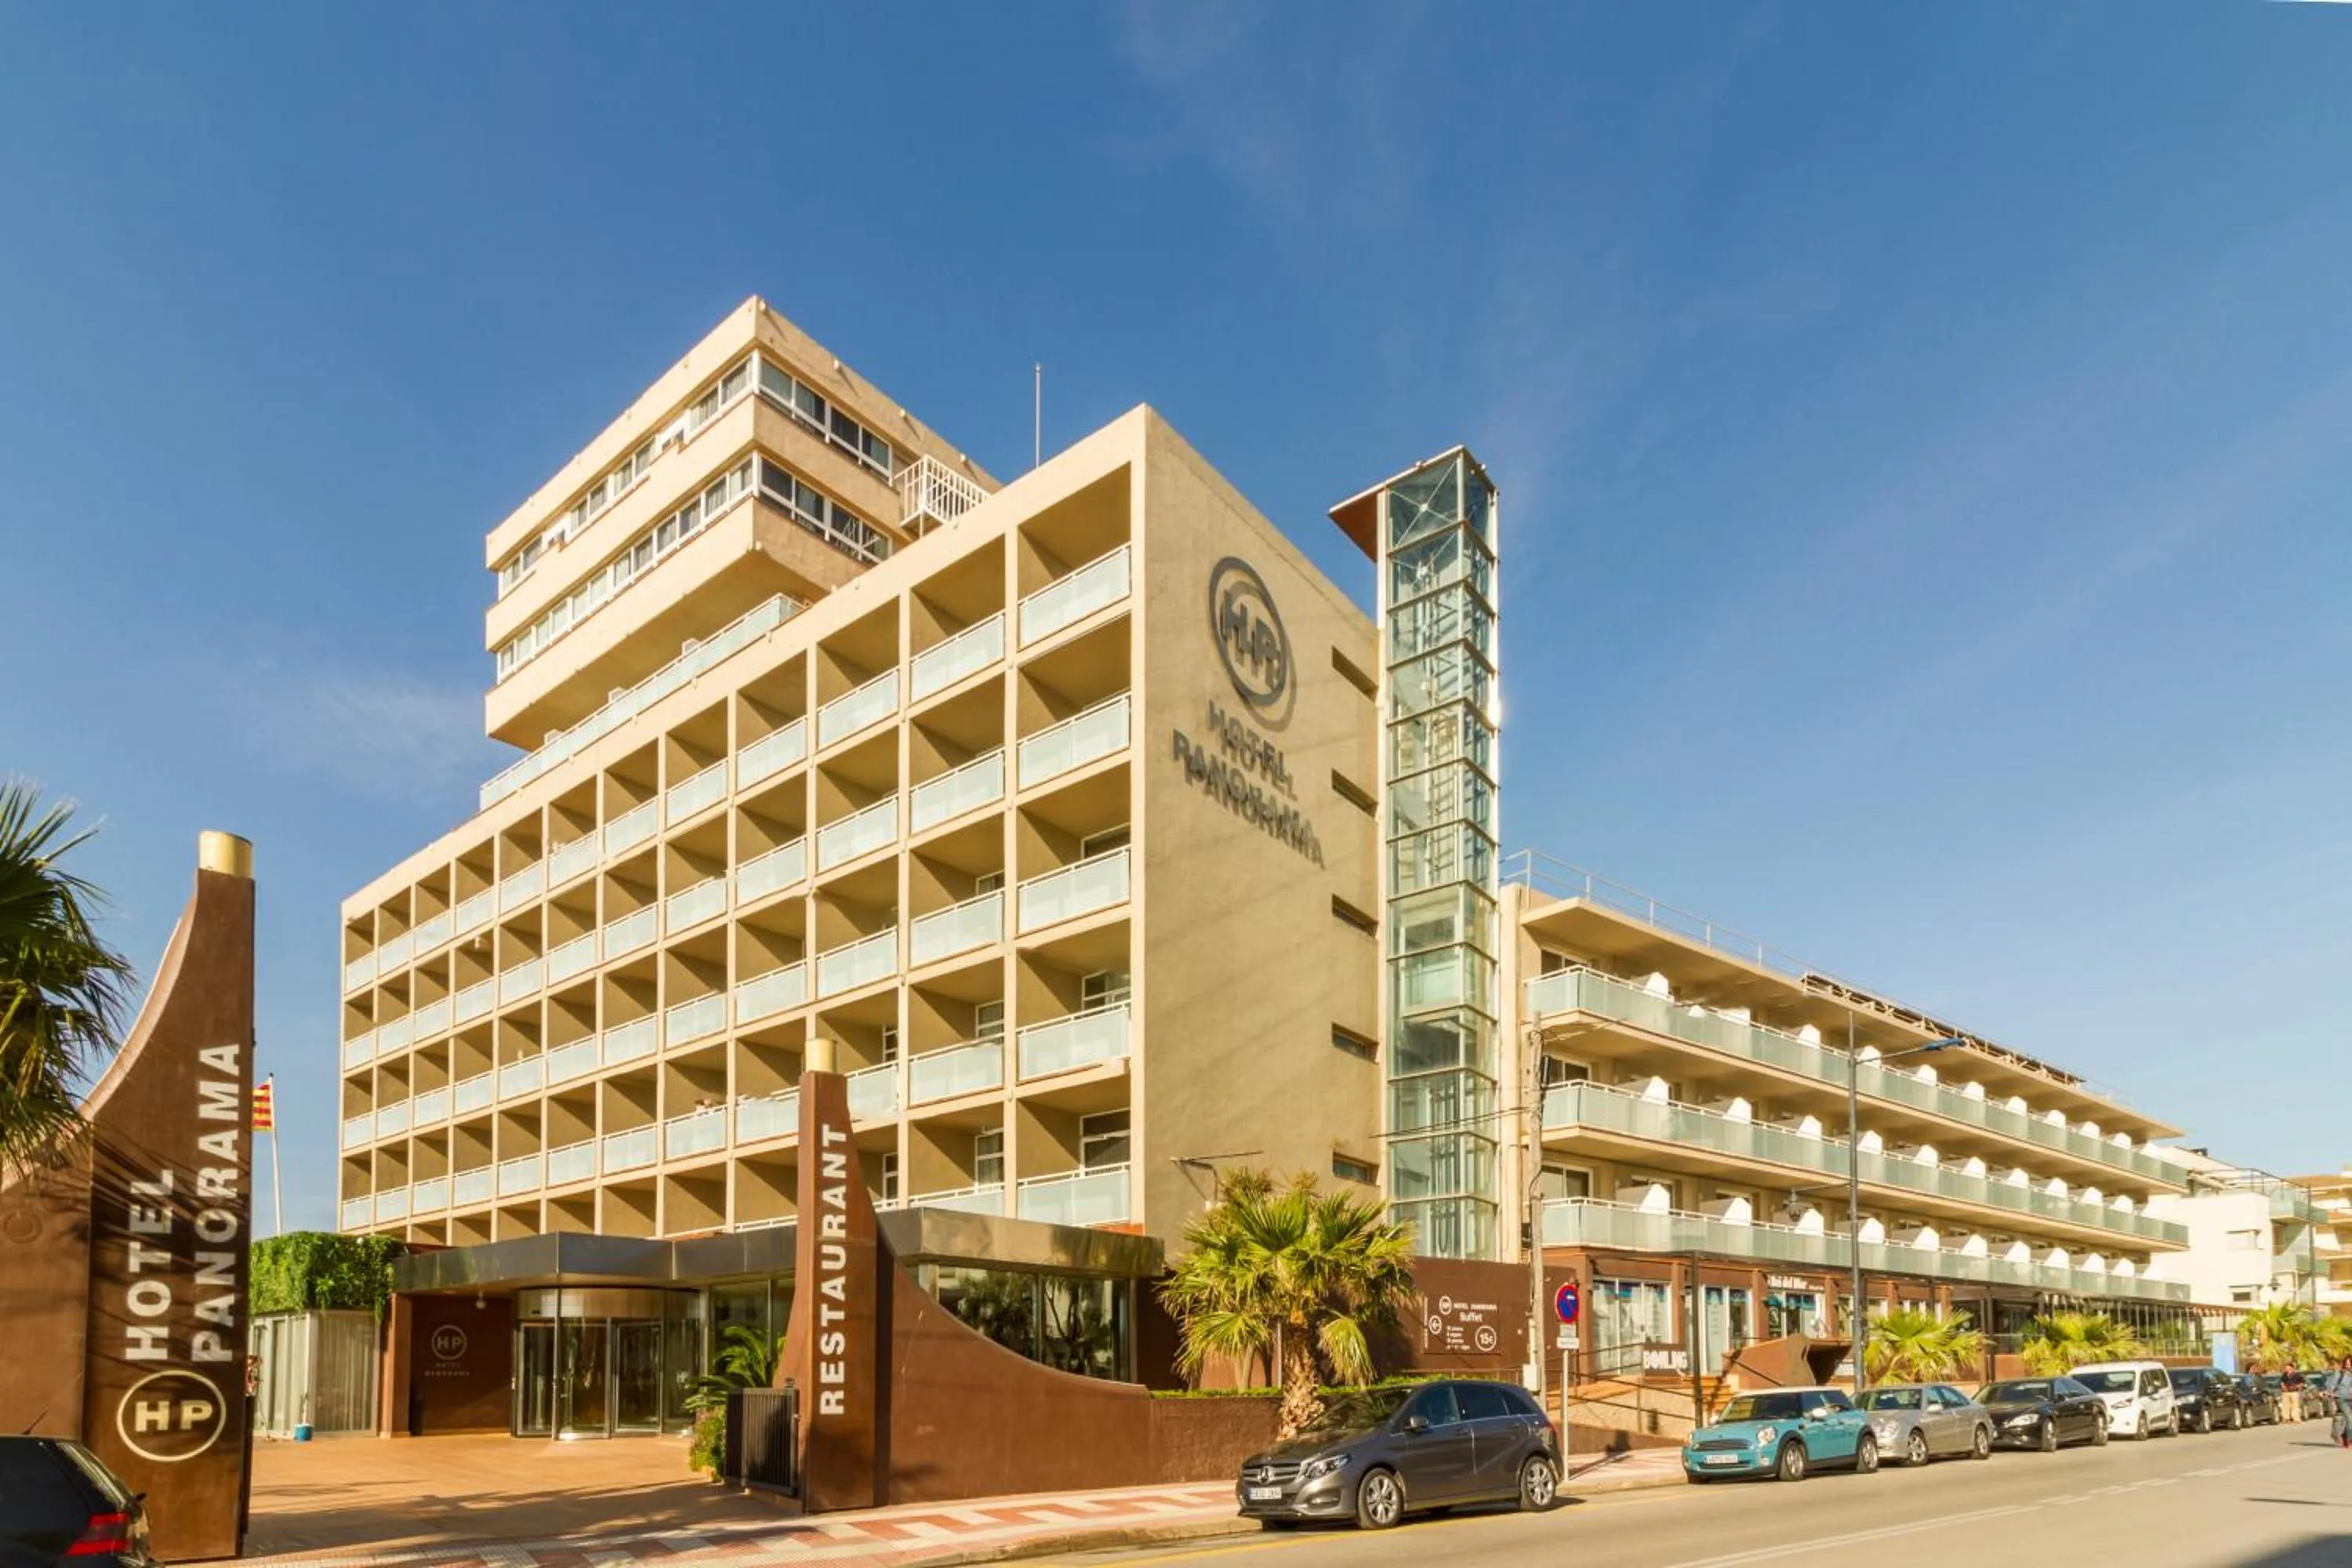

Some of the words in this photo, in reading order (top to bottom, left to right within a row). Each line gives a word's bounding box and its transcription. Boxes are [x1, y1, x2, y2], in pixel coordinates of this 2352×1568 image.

[1224, 590, 1277, 665] HP
[1173, 728, 1319, 855] PANORAMA
[1208, 699, 1290, 784] HOTEL
[191, 1044, 240, 1362] PANORAMA
[125, 1169, 173, 1360] HOTEL
[819, 1123, 847, 1414] RESTAURANT
[437, 1336, 463, 1349] HP
[134, 1399, 213, 1432] HP
